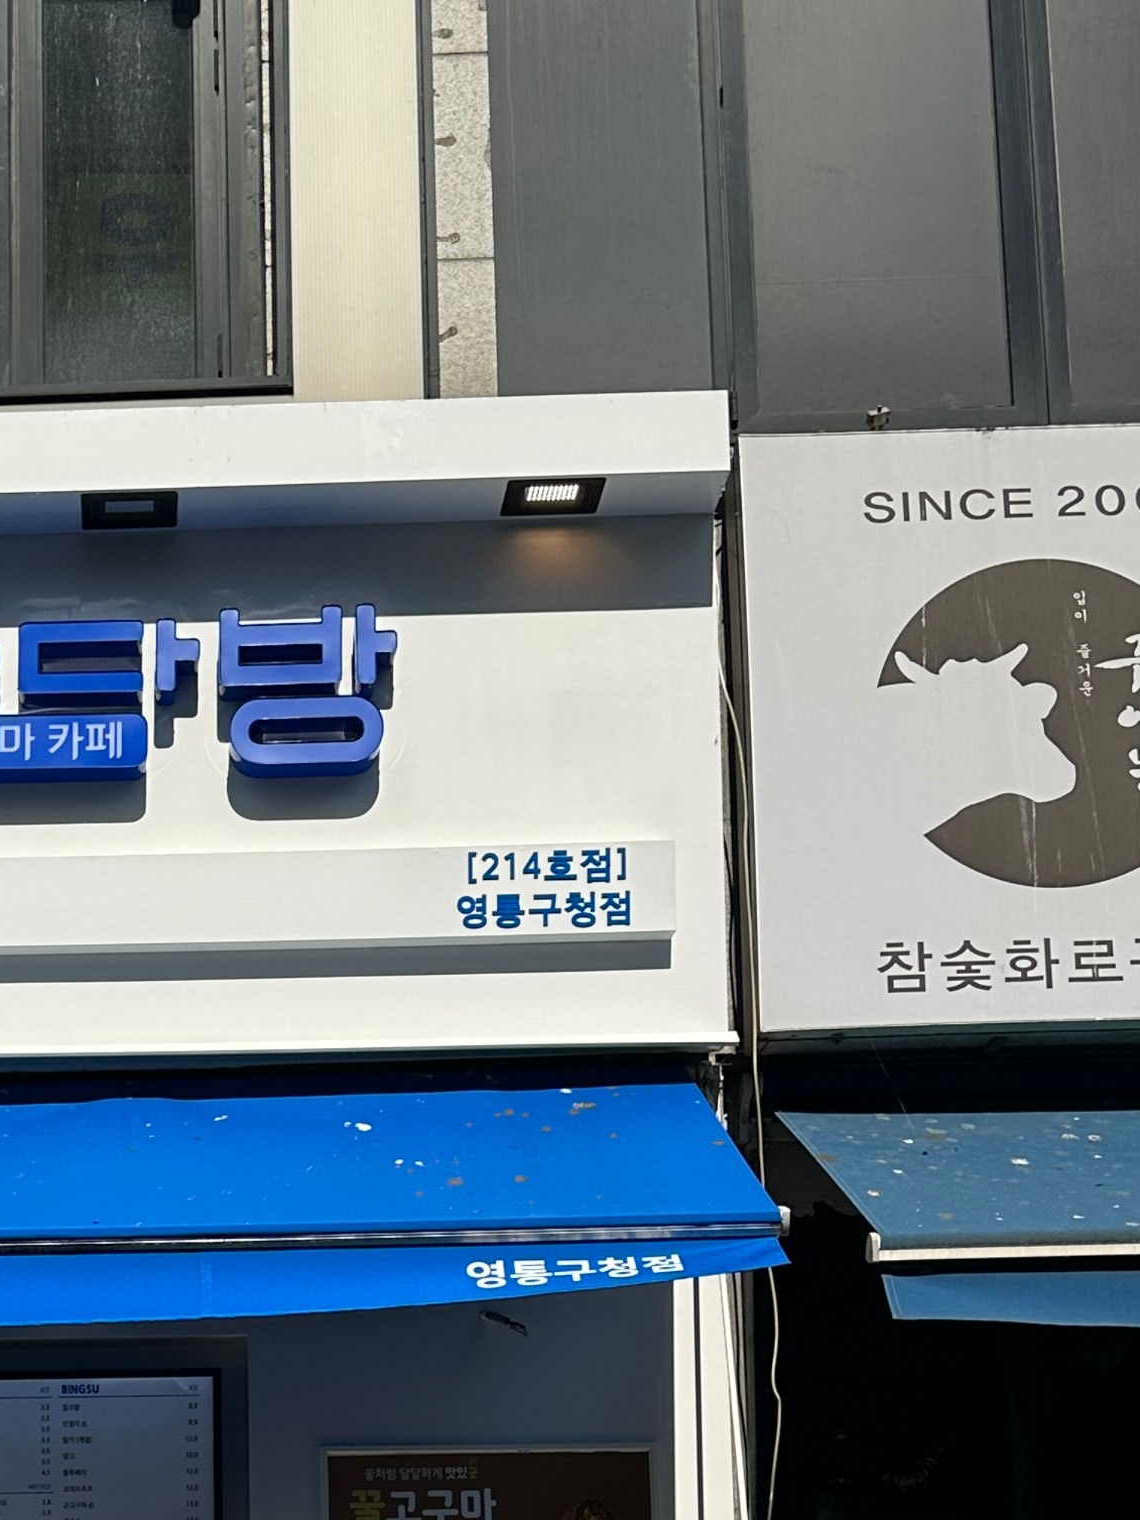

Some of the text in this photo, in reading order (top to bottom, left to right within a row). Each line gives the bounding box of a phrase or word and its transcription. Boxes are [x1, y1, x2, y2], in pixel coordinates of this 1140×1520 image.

[864, 485, 1140, 523] SINCE 20
[1073, 590, 1094, 697] 입이 즐거운
[48, 721, 123, 761] 카페
[466, 846, 629, 882] [214호점]
[456, 889, 633, 930] 영통구청점
[877, 937, 1140, 994] 참숯화로
[466, 1253, 685, 1289] 영통구청점
[61, 1384, 99, 1394] BINGSU
[364, 1466, 396, 1481] 꿀처럼
[399, 1466, 443, 1480] 달달하게
